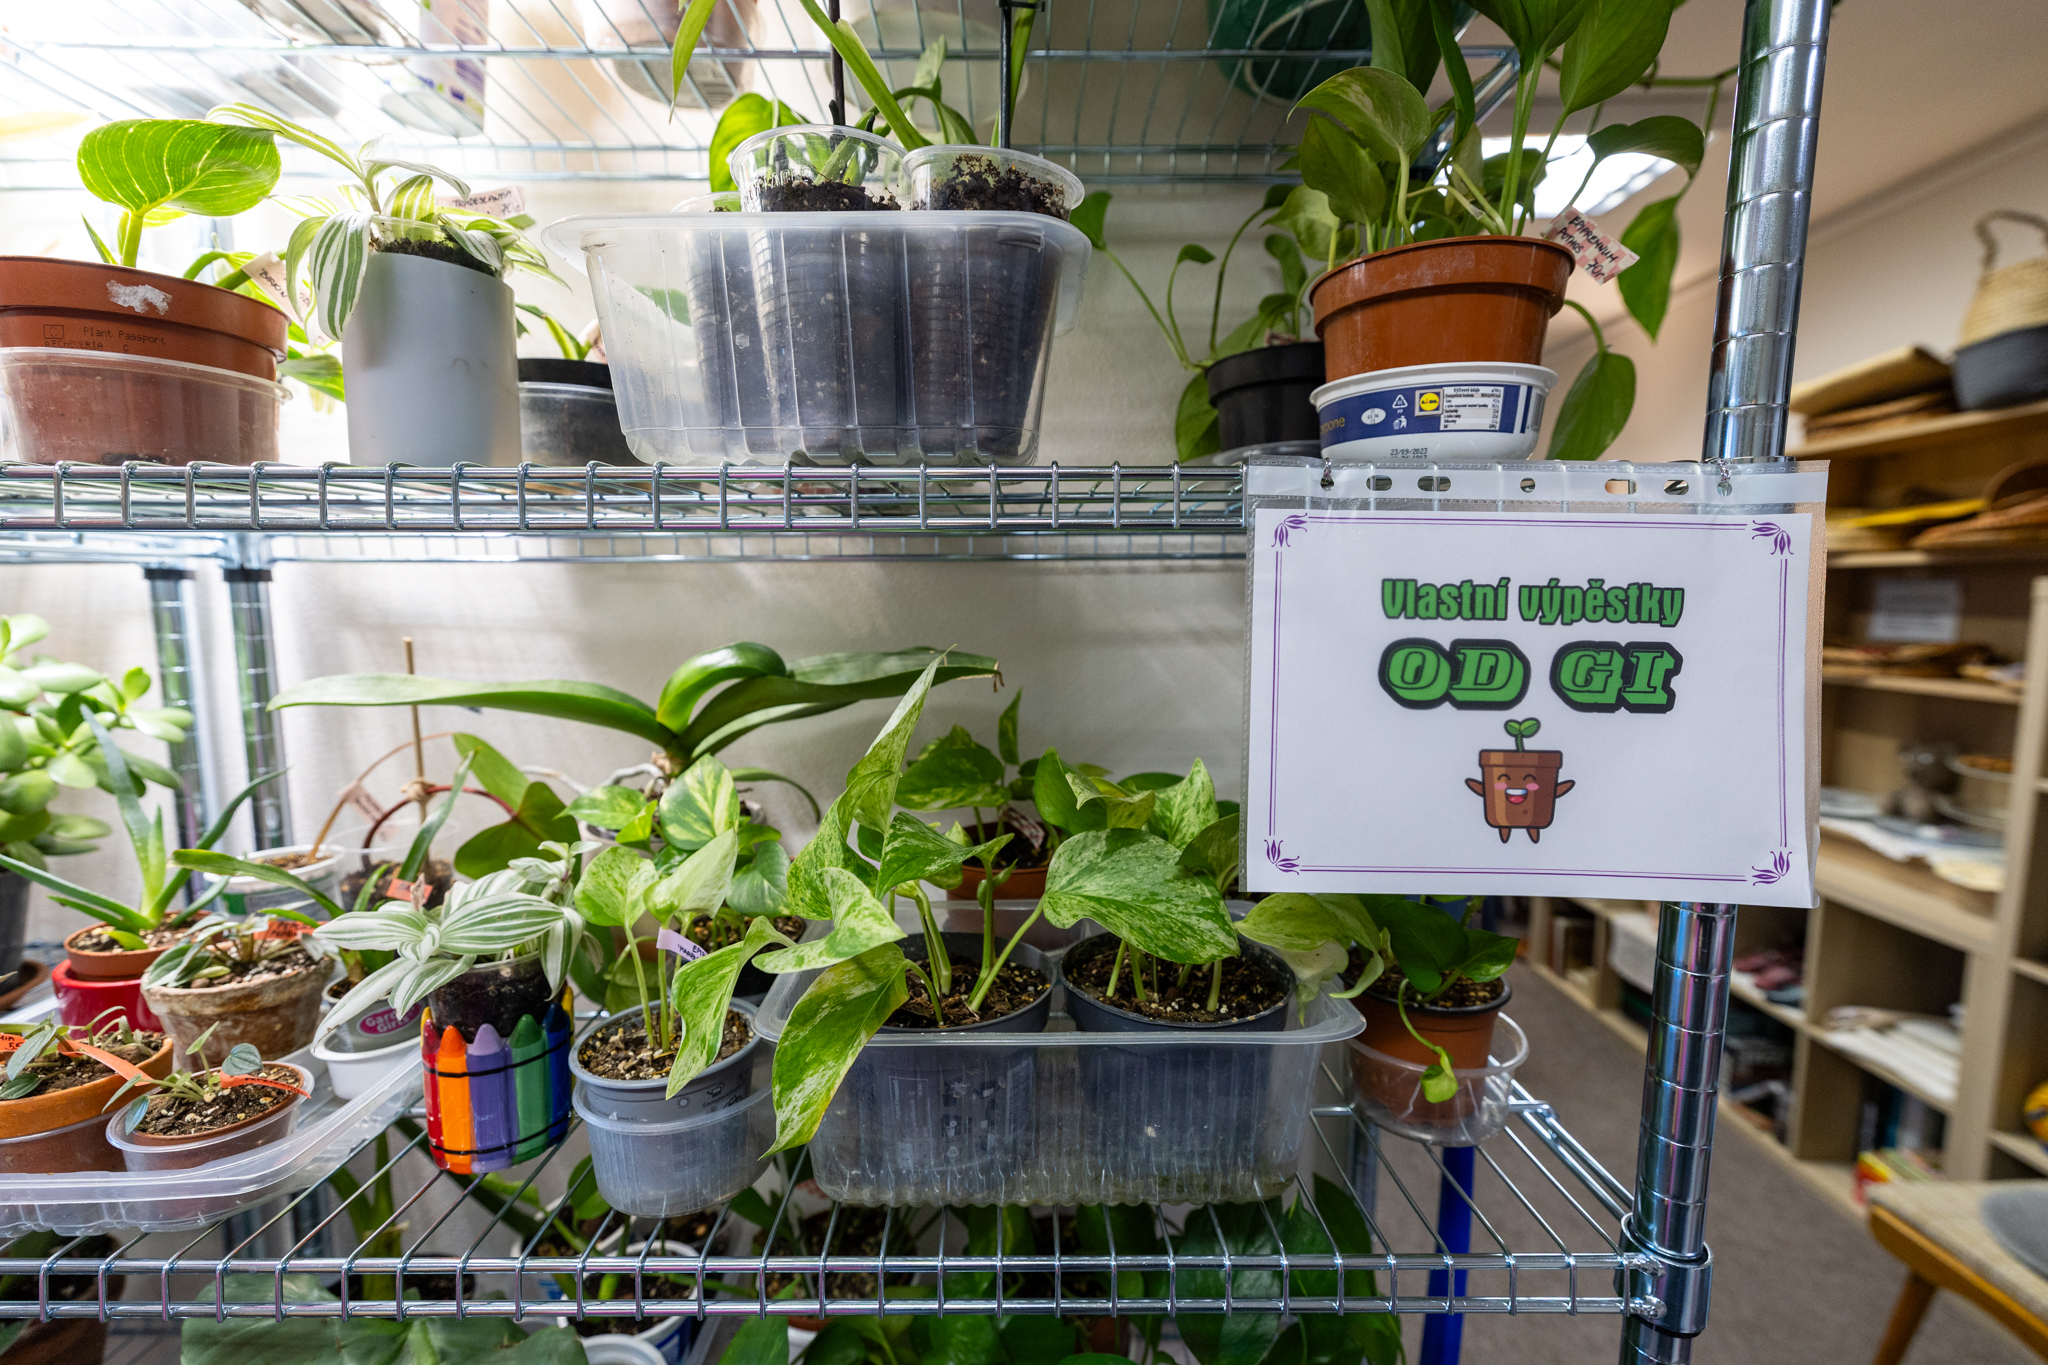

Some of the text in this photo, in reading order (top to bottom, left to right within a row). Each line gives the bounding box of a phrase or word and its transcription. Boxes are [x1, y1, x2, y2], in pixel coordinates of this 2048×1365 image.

[1556, 227, 1584, 254] POTHOS
[83, 326, 166, 345] Plant Passport
[1390, 447, 1428, 456] 23/09/2023
[1381, 576, 1684, 628] Vlastní výpěstky
[1378, 637, 1684, 714] OD GI
